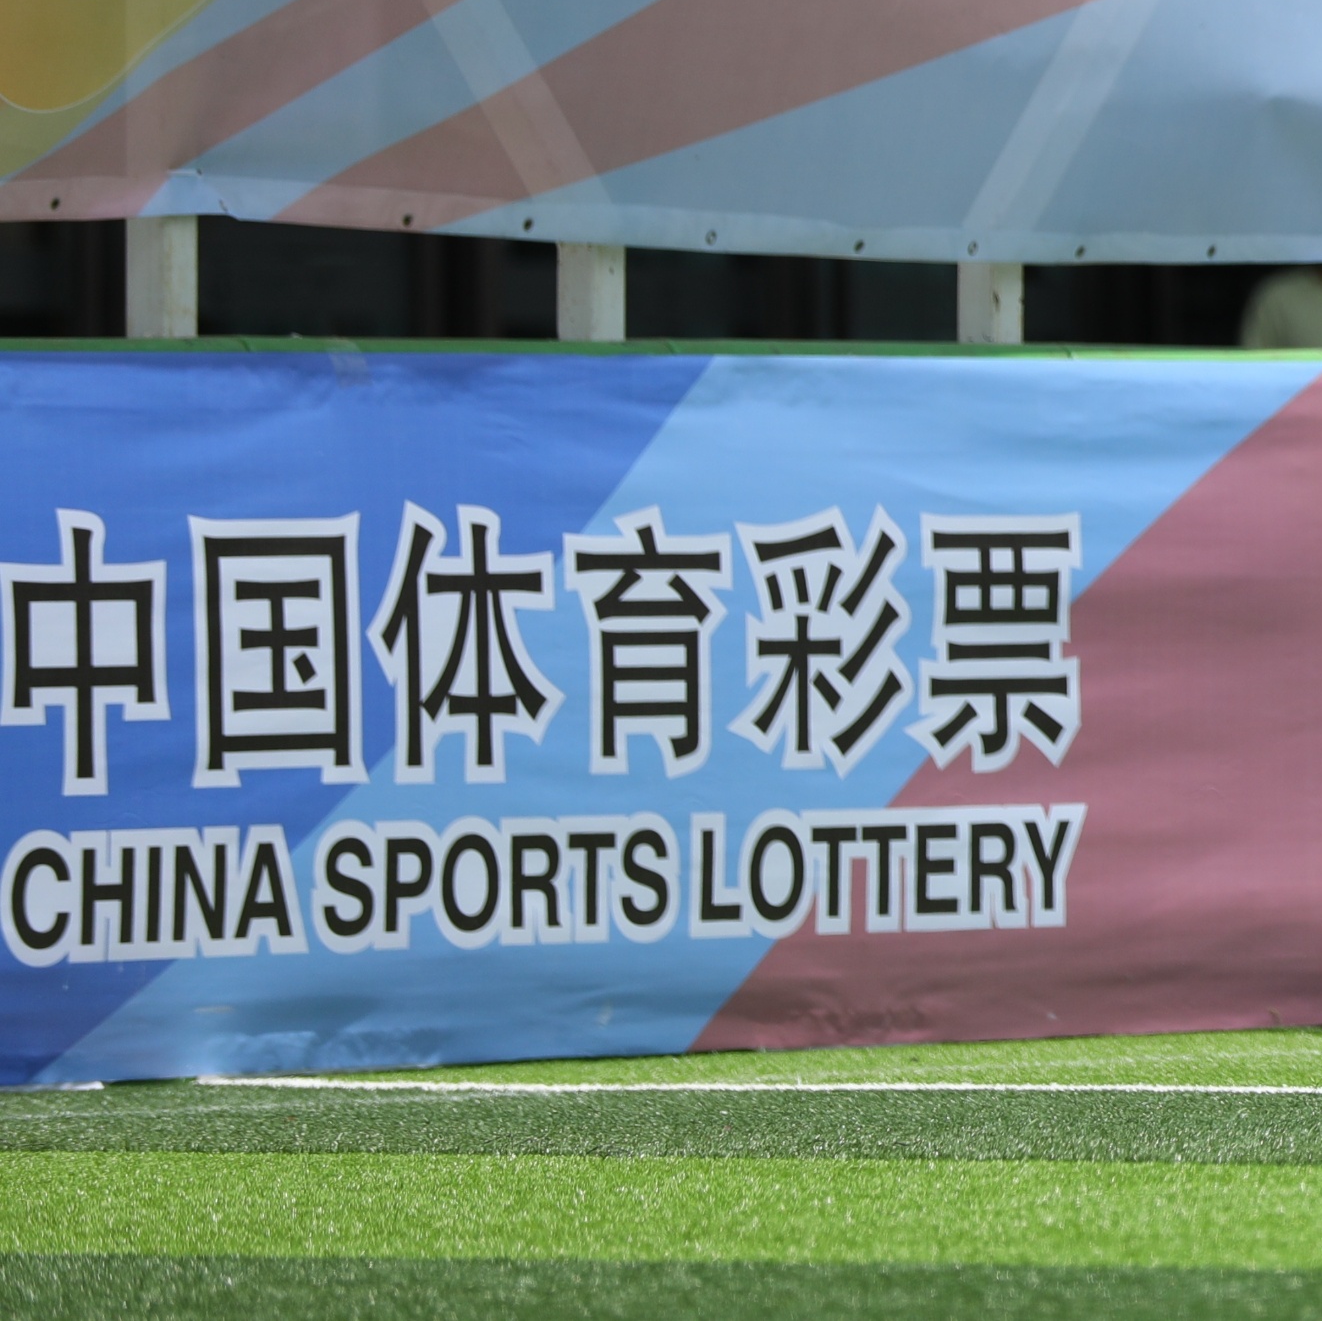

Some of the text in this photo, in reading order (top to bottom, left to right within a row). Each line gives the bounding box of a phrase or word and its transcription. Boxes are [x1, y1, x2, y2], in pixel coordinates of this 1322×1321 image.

[11, 510, 1073, 780] 中国体育彩票
[10, 821, 1073, 951] CHINA SPORTS LOTTERY
